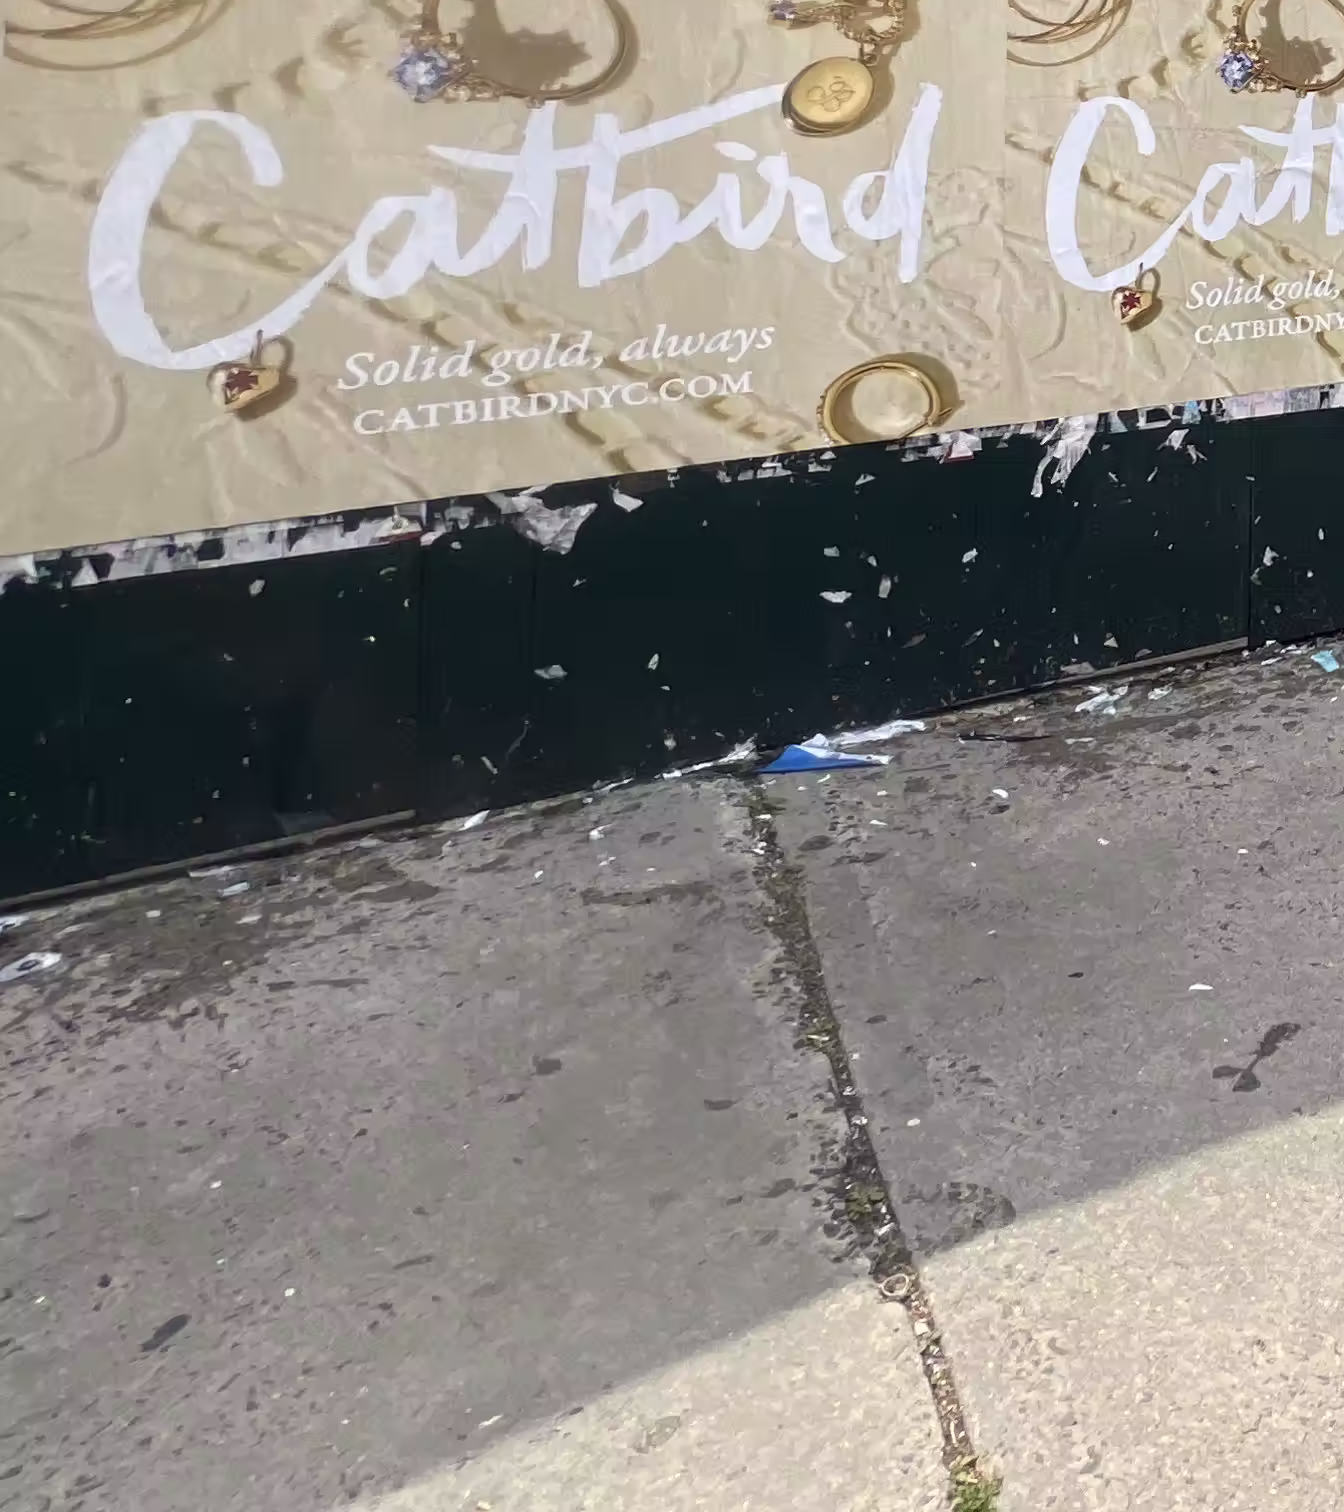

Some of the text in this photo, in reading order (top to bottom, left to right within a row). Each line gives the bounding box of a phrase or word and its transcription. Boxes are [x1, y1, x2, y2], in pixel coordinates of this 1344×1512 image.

[86, 82, 944, 370] Catbird
[1185, 274, 1265, 310] Solid
[1267, 269, 1340, 311] gold,
[336, 323, 776, 390] Solid gold, always
[352, 370, 754, 435] CATBIRDNYC.COM
